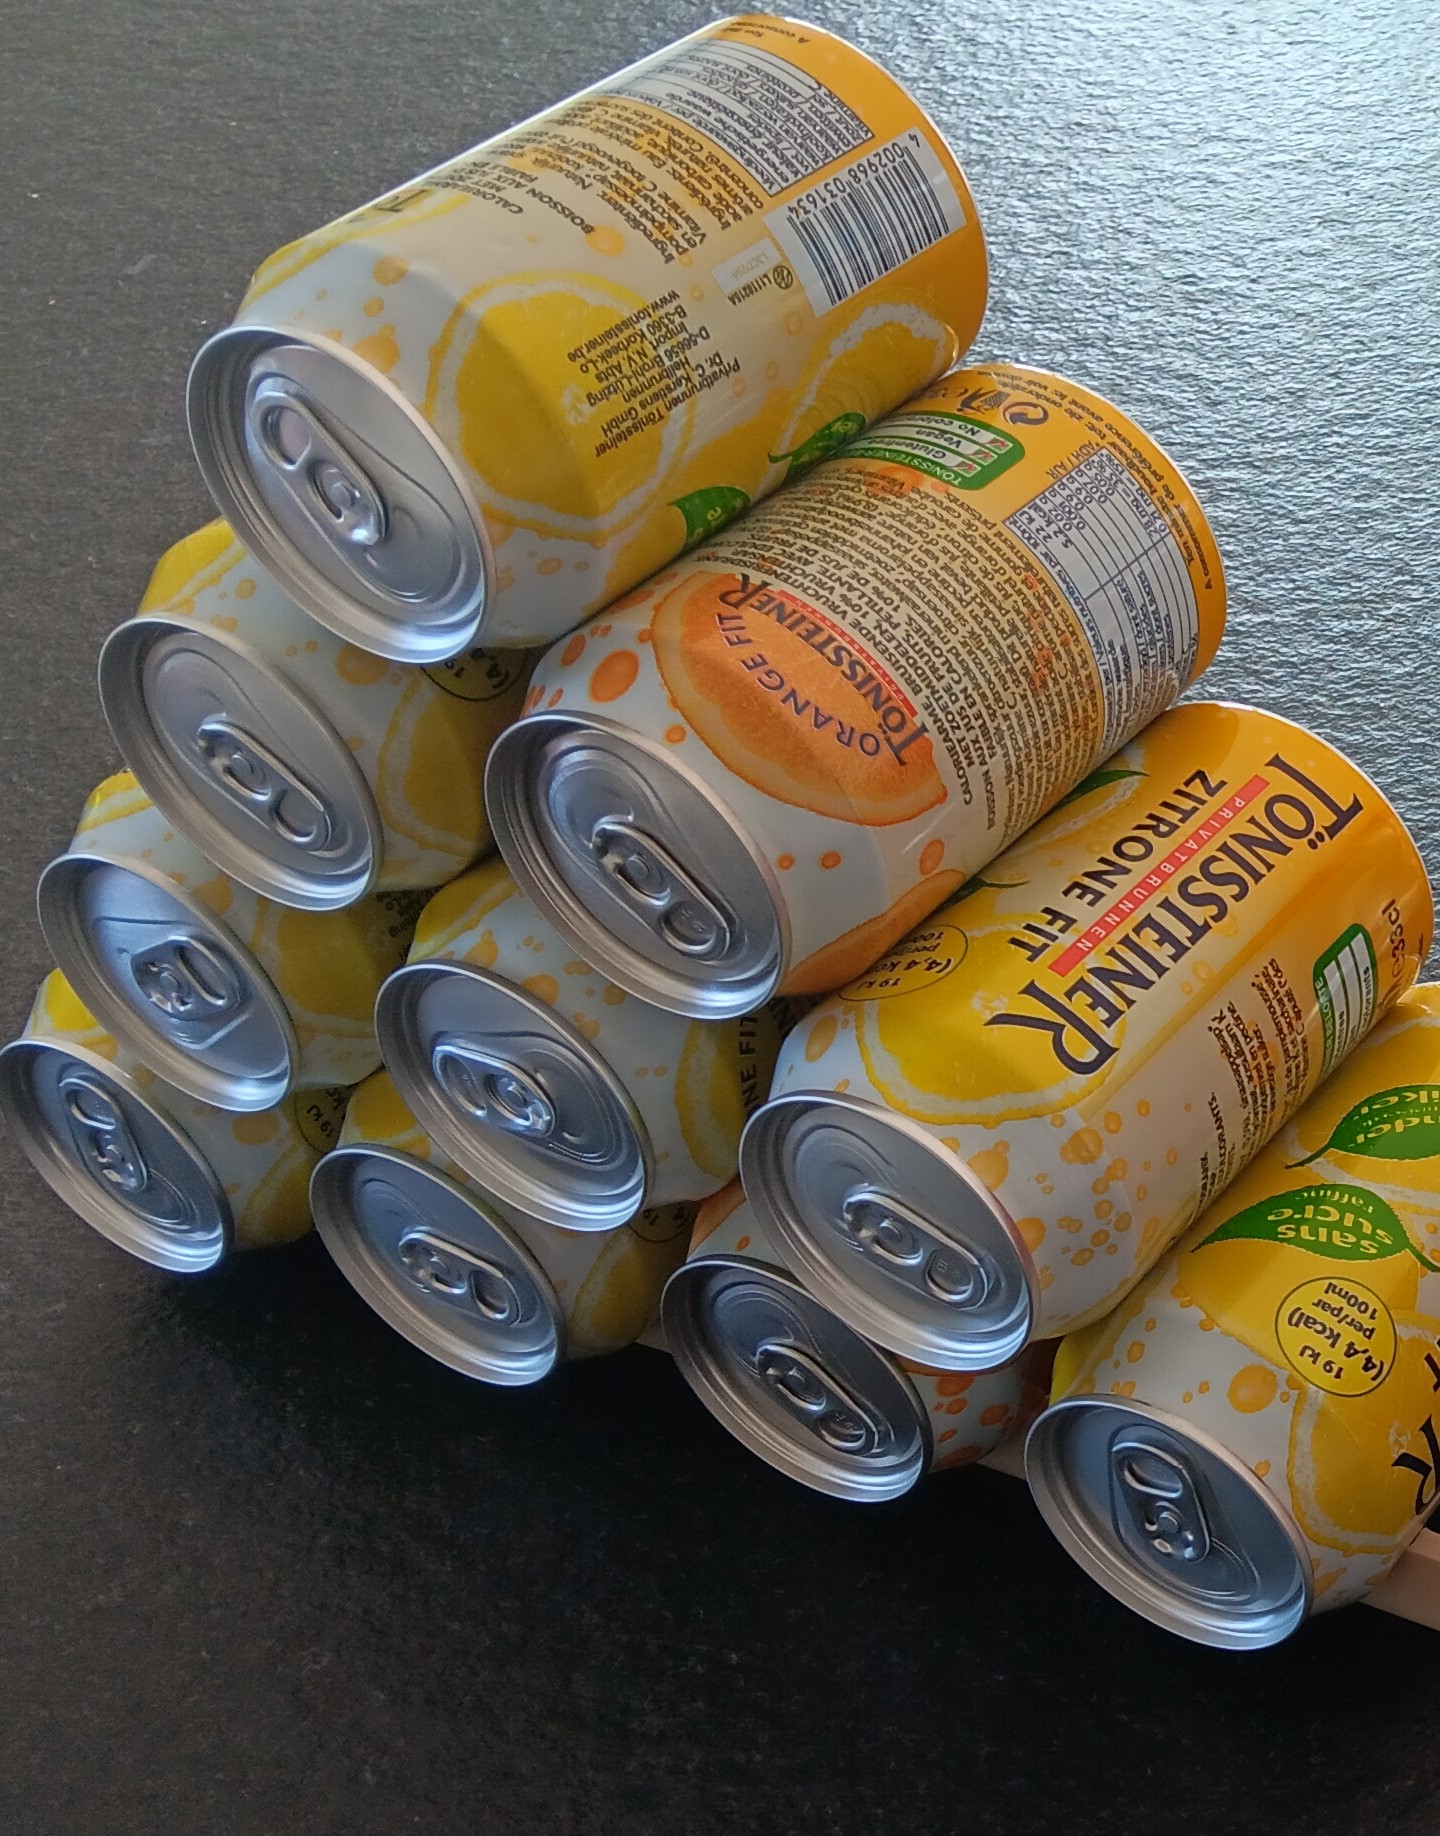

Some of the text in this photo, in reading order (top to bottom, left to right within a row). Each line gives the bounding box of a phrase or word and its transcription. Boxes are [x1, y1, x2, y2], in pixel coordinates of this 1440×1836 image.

[785, 130, 922, 222] 4 002968 031634
[566, 288, 680, 365] www.tonissteiner.be
[577, 304, 687, 378] B-3360 Korbeek-Lo
[620, 354, 691, 404] Heilbrunnen
[704, 351, 724, 370] Dr.
[591, 356, 743, 460] Privatbrunnen Tönissteiner
[636, 371, 694, 413] Kerstiens
[599, 404, 640, 437] GmbH
[915, 427, 962, 448] Vegan
[1017, 506, 1053, 544] 22 kJ
[1027, 500, 1057, 528] kcal
[817, 552, 848, 574] JUS
[907, 551, 929, 571] en
[915, 541, 941, 564] van
[847, 568, 870, 589] DE
[938, 560, 973, 595] bevat
[973, 563, 995, 583] de
[837, 590, 869, 619] 10%
[869, 583, 901, 613] 10%
[1052, 566, 1091, 621] nutritives
[968, 592, 1013, 642] product
[716, 570, 930, 766] TÖNISSTEINER
[847, 617, 922, 695] BRUISENDE
[1002, 641, 1024, 664] Dit
[713, 609, 883, 754] ORANGE FIT
[940, 682, 961, 705] DE
[957, 685, 976, 709] EN
[953, 704, 976, 732] JUS
[970, 708, 999, 759] FAIBLE
[954, 734, 977, 768] MET
[967, 734, 990, 767] AUX
[1060, 766, 1229, 916] ZITRONE
[1073, 793, 1247, 955] PRIVATBRUNNEN
[981, 751, 1363, 1075] TÖNISSTEINER
[1006, 904, 1077, 965] FIT
[1266, 1204, 1392, 1245] sucre
[1274, 1220, 1381, 1255] sans
[1311, 1298, 1375, 1340] per/par
[1323, 1282, 1376, 1320] 100ml
[1286, 1305, 1385, 1381] (4,4 kcal)
[1299, 1346, 1343, 1379] 19 kJ
